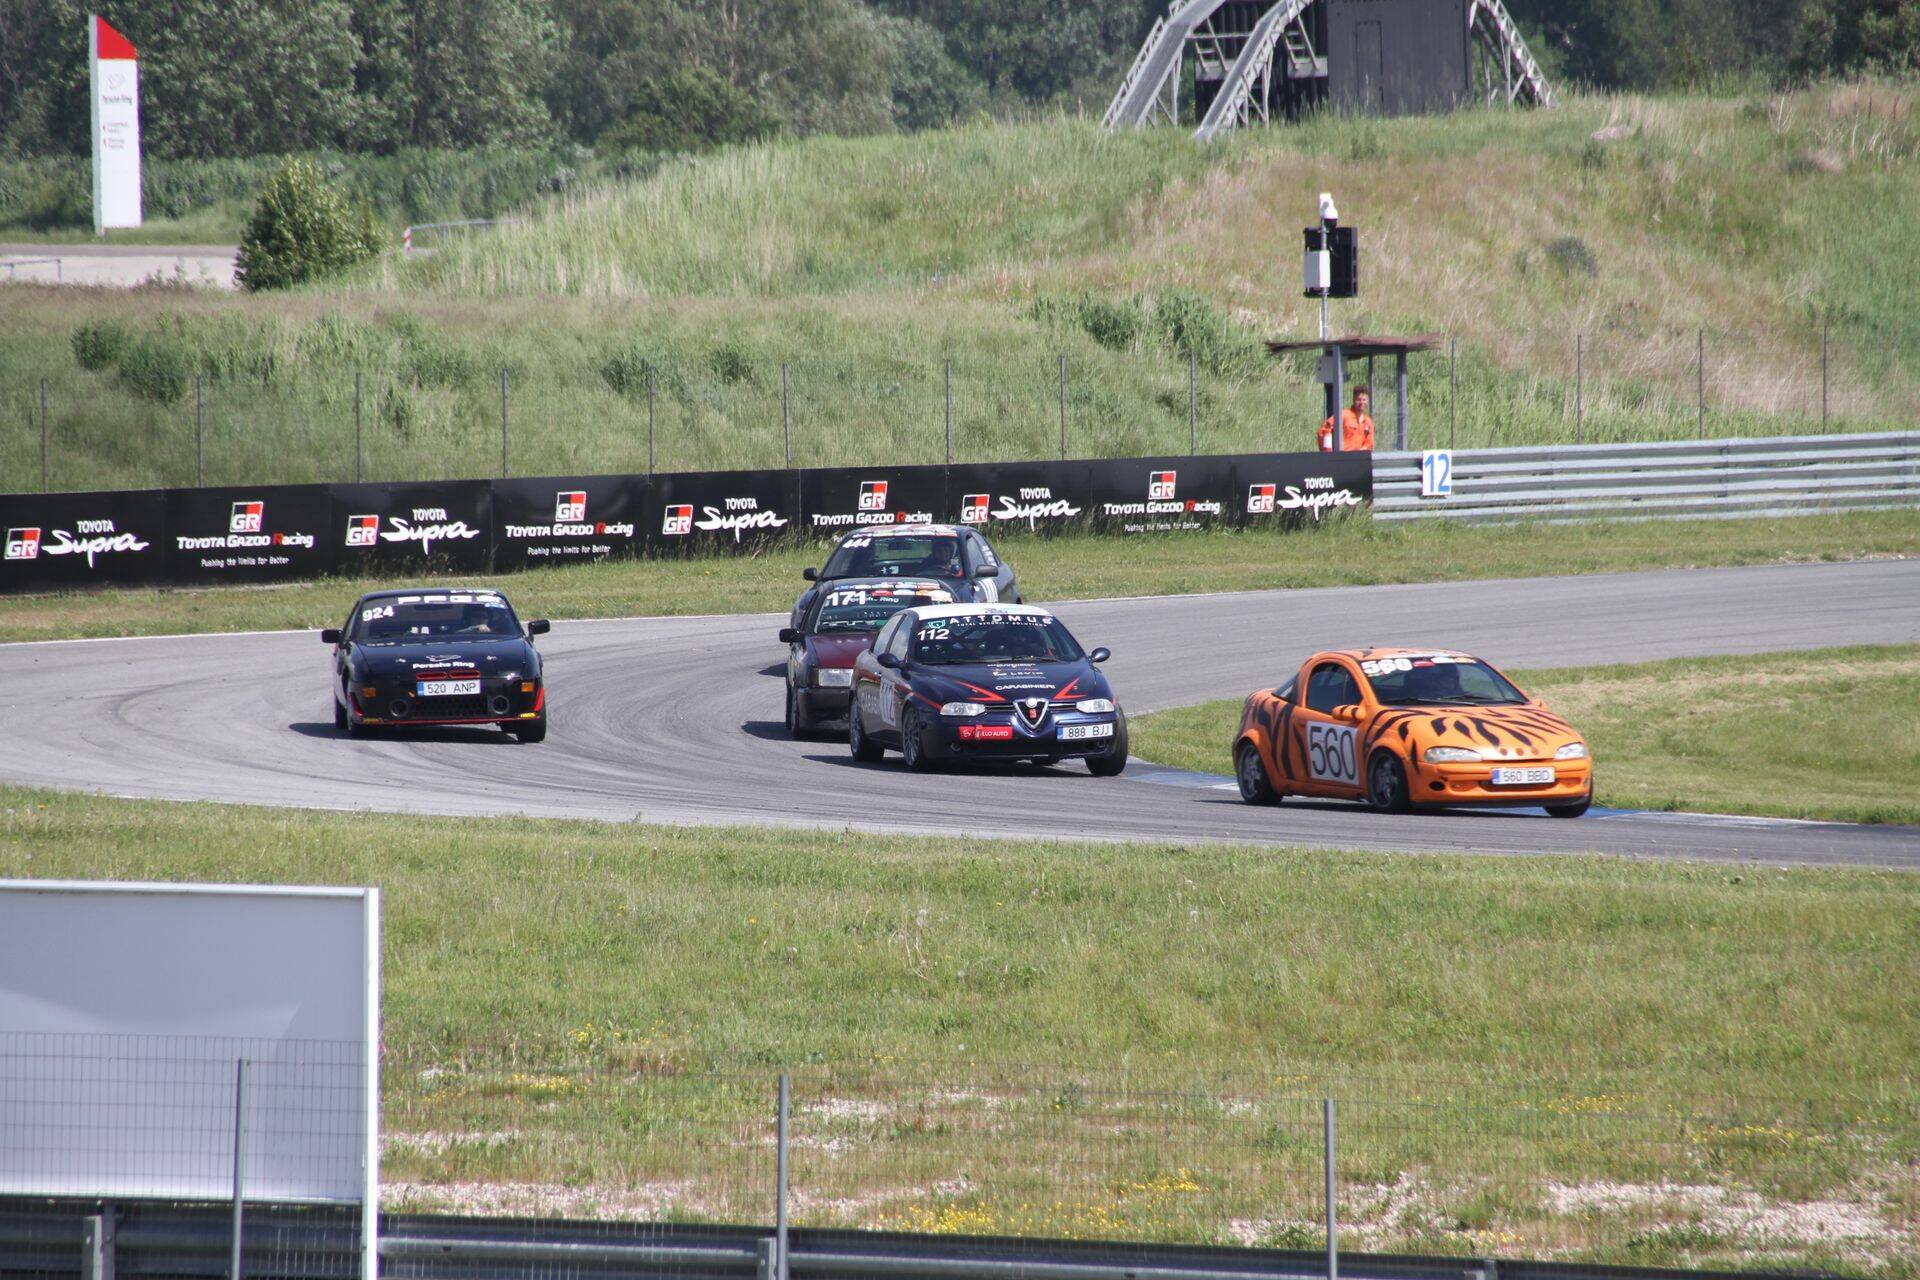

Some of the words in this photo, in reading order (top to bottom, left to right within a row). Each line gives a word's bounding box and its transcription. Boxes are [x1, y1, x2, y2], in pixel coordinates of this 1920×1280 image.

[1425, 454, 1450, 492] 12
[1150, 482, 1175, 497] GR
[1304, 477, 1334, 489] TOYOTA
[860, 492, 886, 508] GR
[1020, 487, 1051, 500] TOYOTA
[558, 503, 585, 519] GR
[725, 498, 757, 510] TOYOTA
[1103, 503, 1145, 515] TOYOTA
[1146, 501, 1185, 513] GAZOO
[1186, 500, 1221, 514] Racing
[1249, 495, 1273, 511] GR
[1277, 486, 1362, 521] Supra
[412, 508, 447, 520] TOYOTA
[812, 514, 854, 525] TOYOTA
[856, 512, 895, 524] GAZOO
[896, 511, 933, 525] Racing
[963, 505, 987, 521] GR
[990, 496, 1081, 532] Supra
[77, 519, 115, 533] TOYOTA
[232, 513, 260, 530] GR
[505, 525, 551, 538] TOYOTA
[552, 523, 595, 536] GAZOO
[596, 521, 634, 537] Racing
[665, 516, 691, 532] GR
[694, 506, 788, 543] Supra
[176, 536, 226, 549] TOYOTA
[227, 534, 271, 548] GAZOO
[273, 532, 314, 548] Racing
[348, 526, 376, 543] GR
[380, 517, 480, 555] Supra
[8, 540, 37, 556] GR
[41, 529, 150, 568] Supra
[527, 546, 550, 556] Pushing
[581, 545, 591, 553] for
[842, 538, 872, 548] 444
[826, 591, 866, 606] 171
[362, 605, 394, 621] 924
[917, 628, 950, 640] 112
[1361, 658, 1413, 675] 560
[427, 684, 446, 694] 520
[453, 682, 477, 693] ANP
[1068, 727, 1086, 737] 888
[1092, 726, 1110, 736] BJJ
[1310, 726, 1356, 779] 560
[1503, 771, 1522, 782] 560
